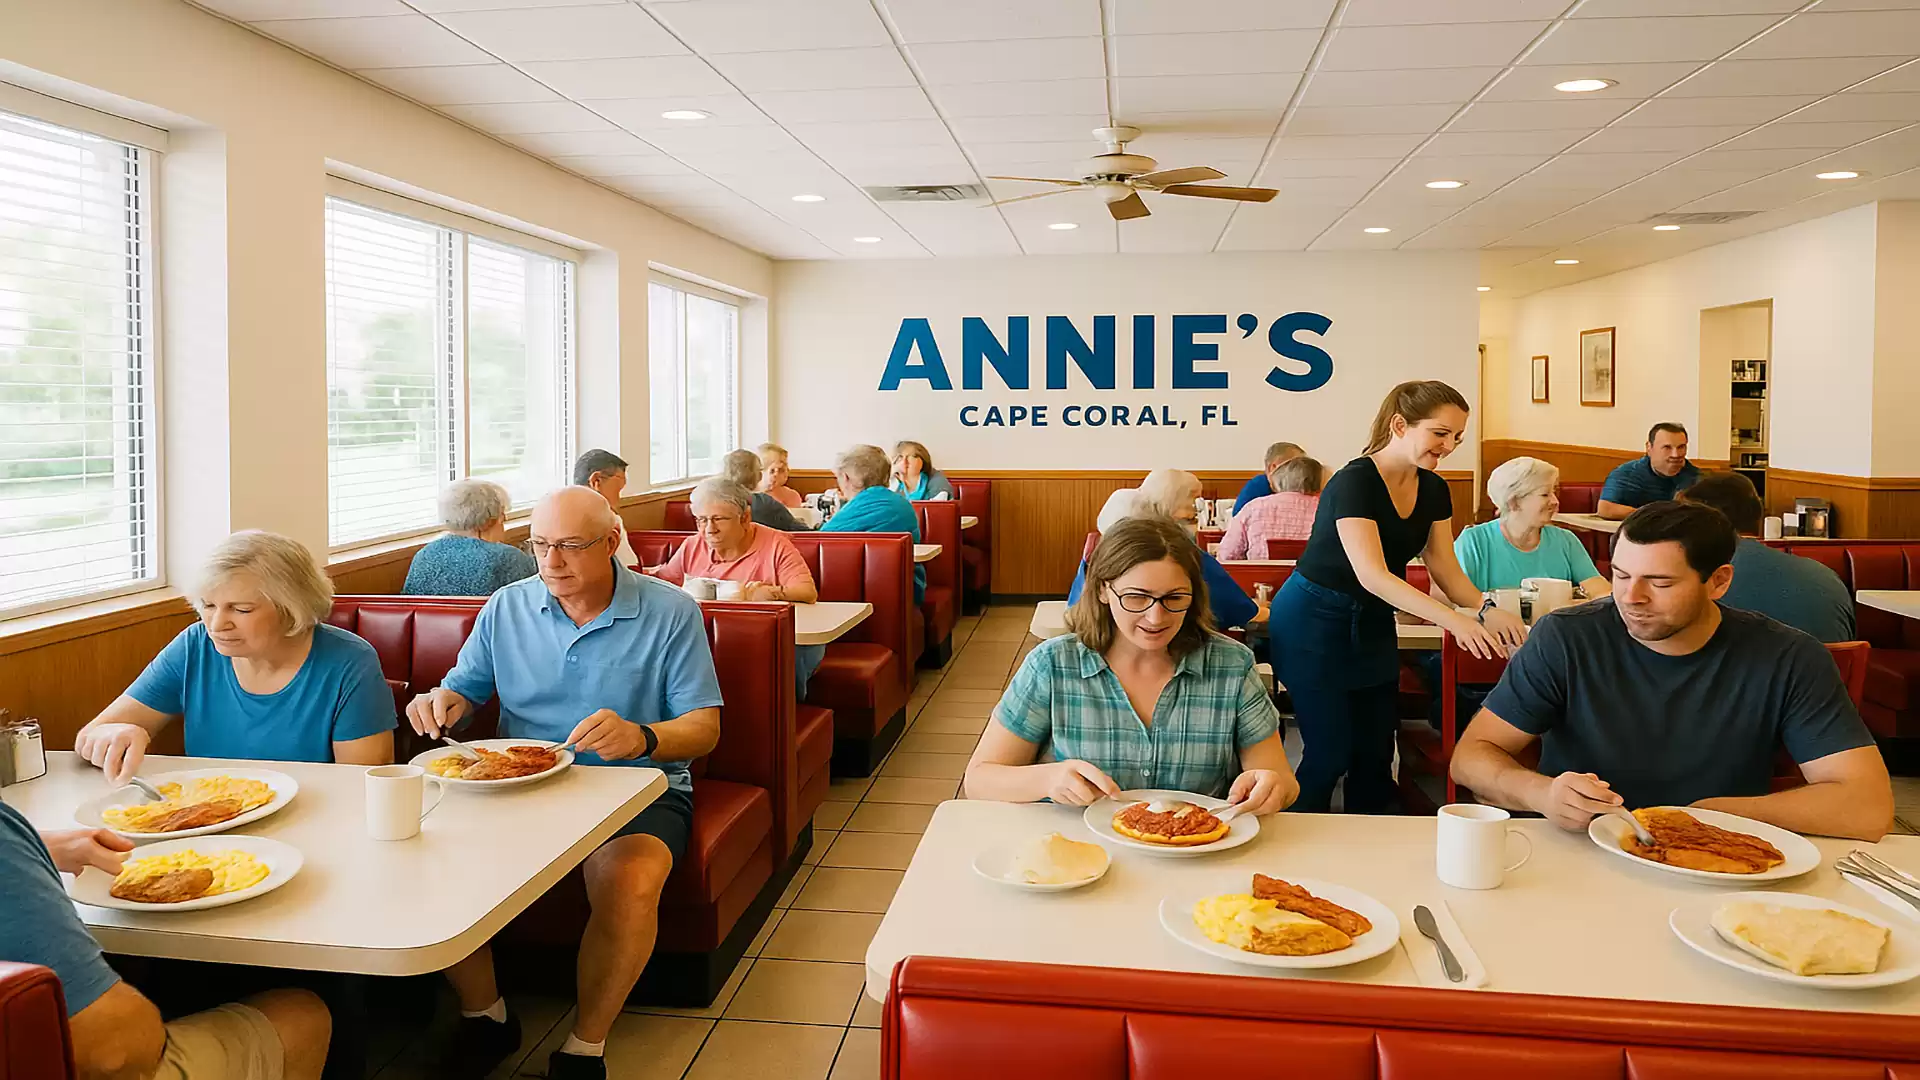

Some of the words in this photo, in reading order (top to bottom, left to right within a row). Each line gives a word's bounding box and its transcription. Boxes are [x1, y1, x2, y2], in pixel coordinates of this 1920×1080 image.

[878, 311, 1334, 392] ANNIE'S
[959, 405, 1048, 427] CAPE
[1062, 405, 1187, 429] CORAL,
[1201, 405, 1238, 426] FL
